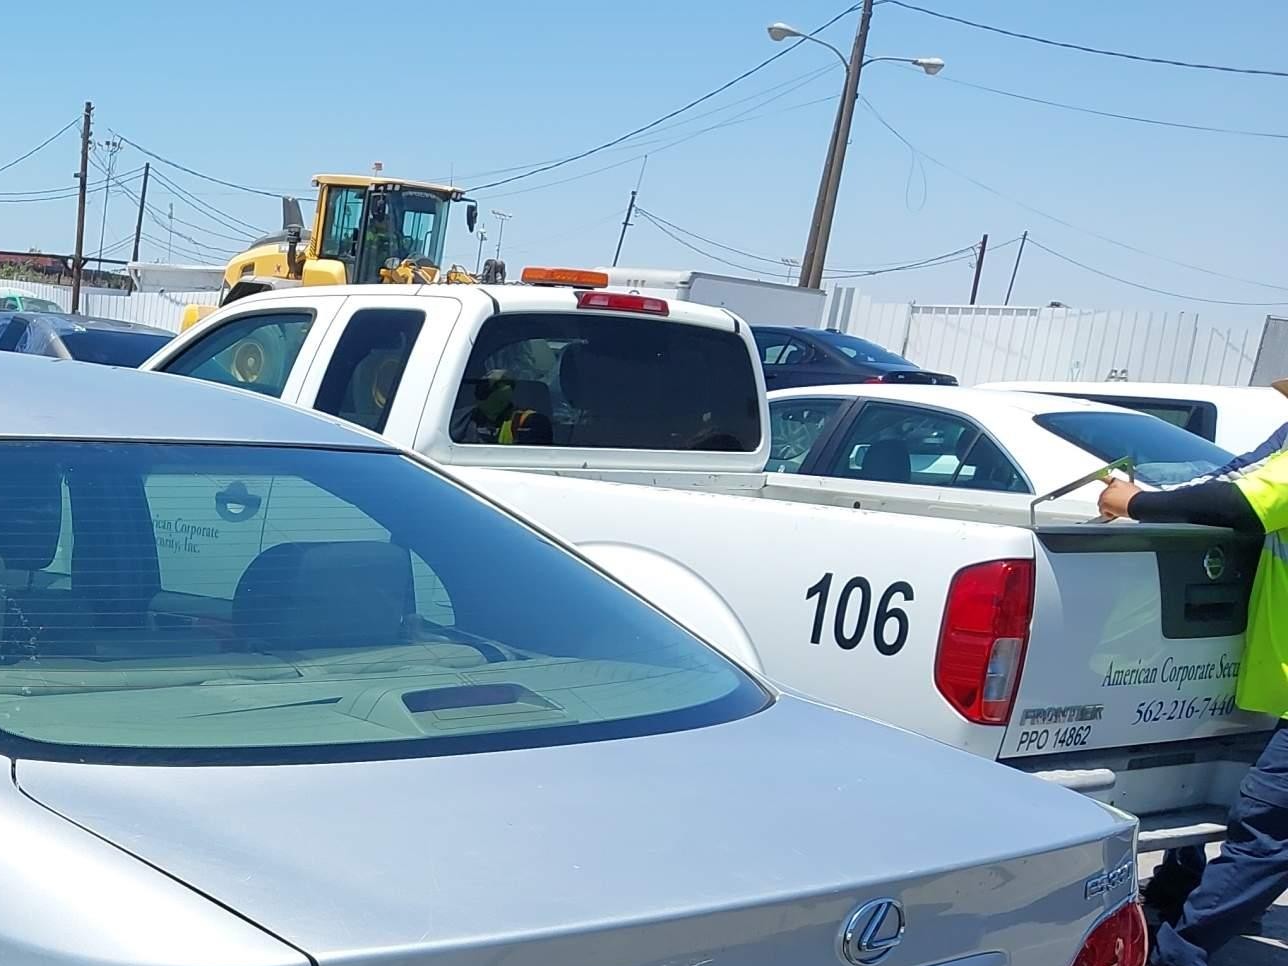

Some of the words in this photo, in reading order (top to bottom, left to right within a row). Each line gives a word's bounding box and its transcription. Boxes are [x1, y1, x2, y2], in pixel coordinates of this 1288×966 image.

[175, 517, 219, 539] Corporate
[184, 535, 200, 553] Inc.
[805, 572, 915, 656] 106
[1101, 659, 1157, 688] American
[1161, 656, 1214, 691] Corporate
[1020, 703, 1105, 727] FRONTIER
[1131, 694, 1237, 726] 562-216-7440
[1016, 729, 1049, 752] PPO
[1053, 725, 1092, 748] 14862
